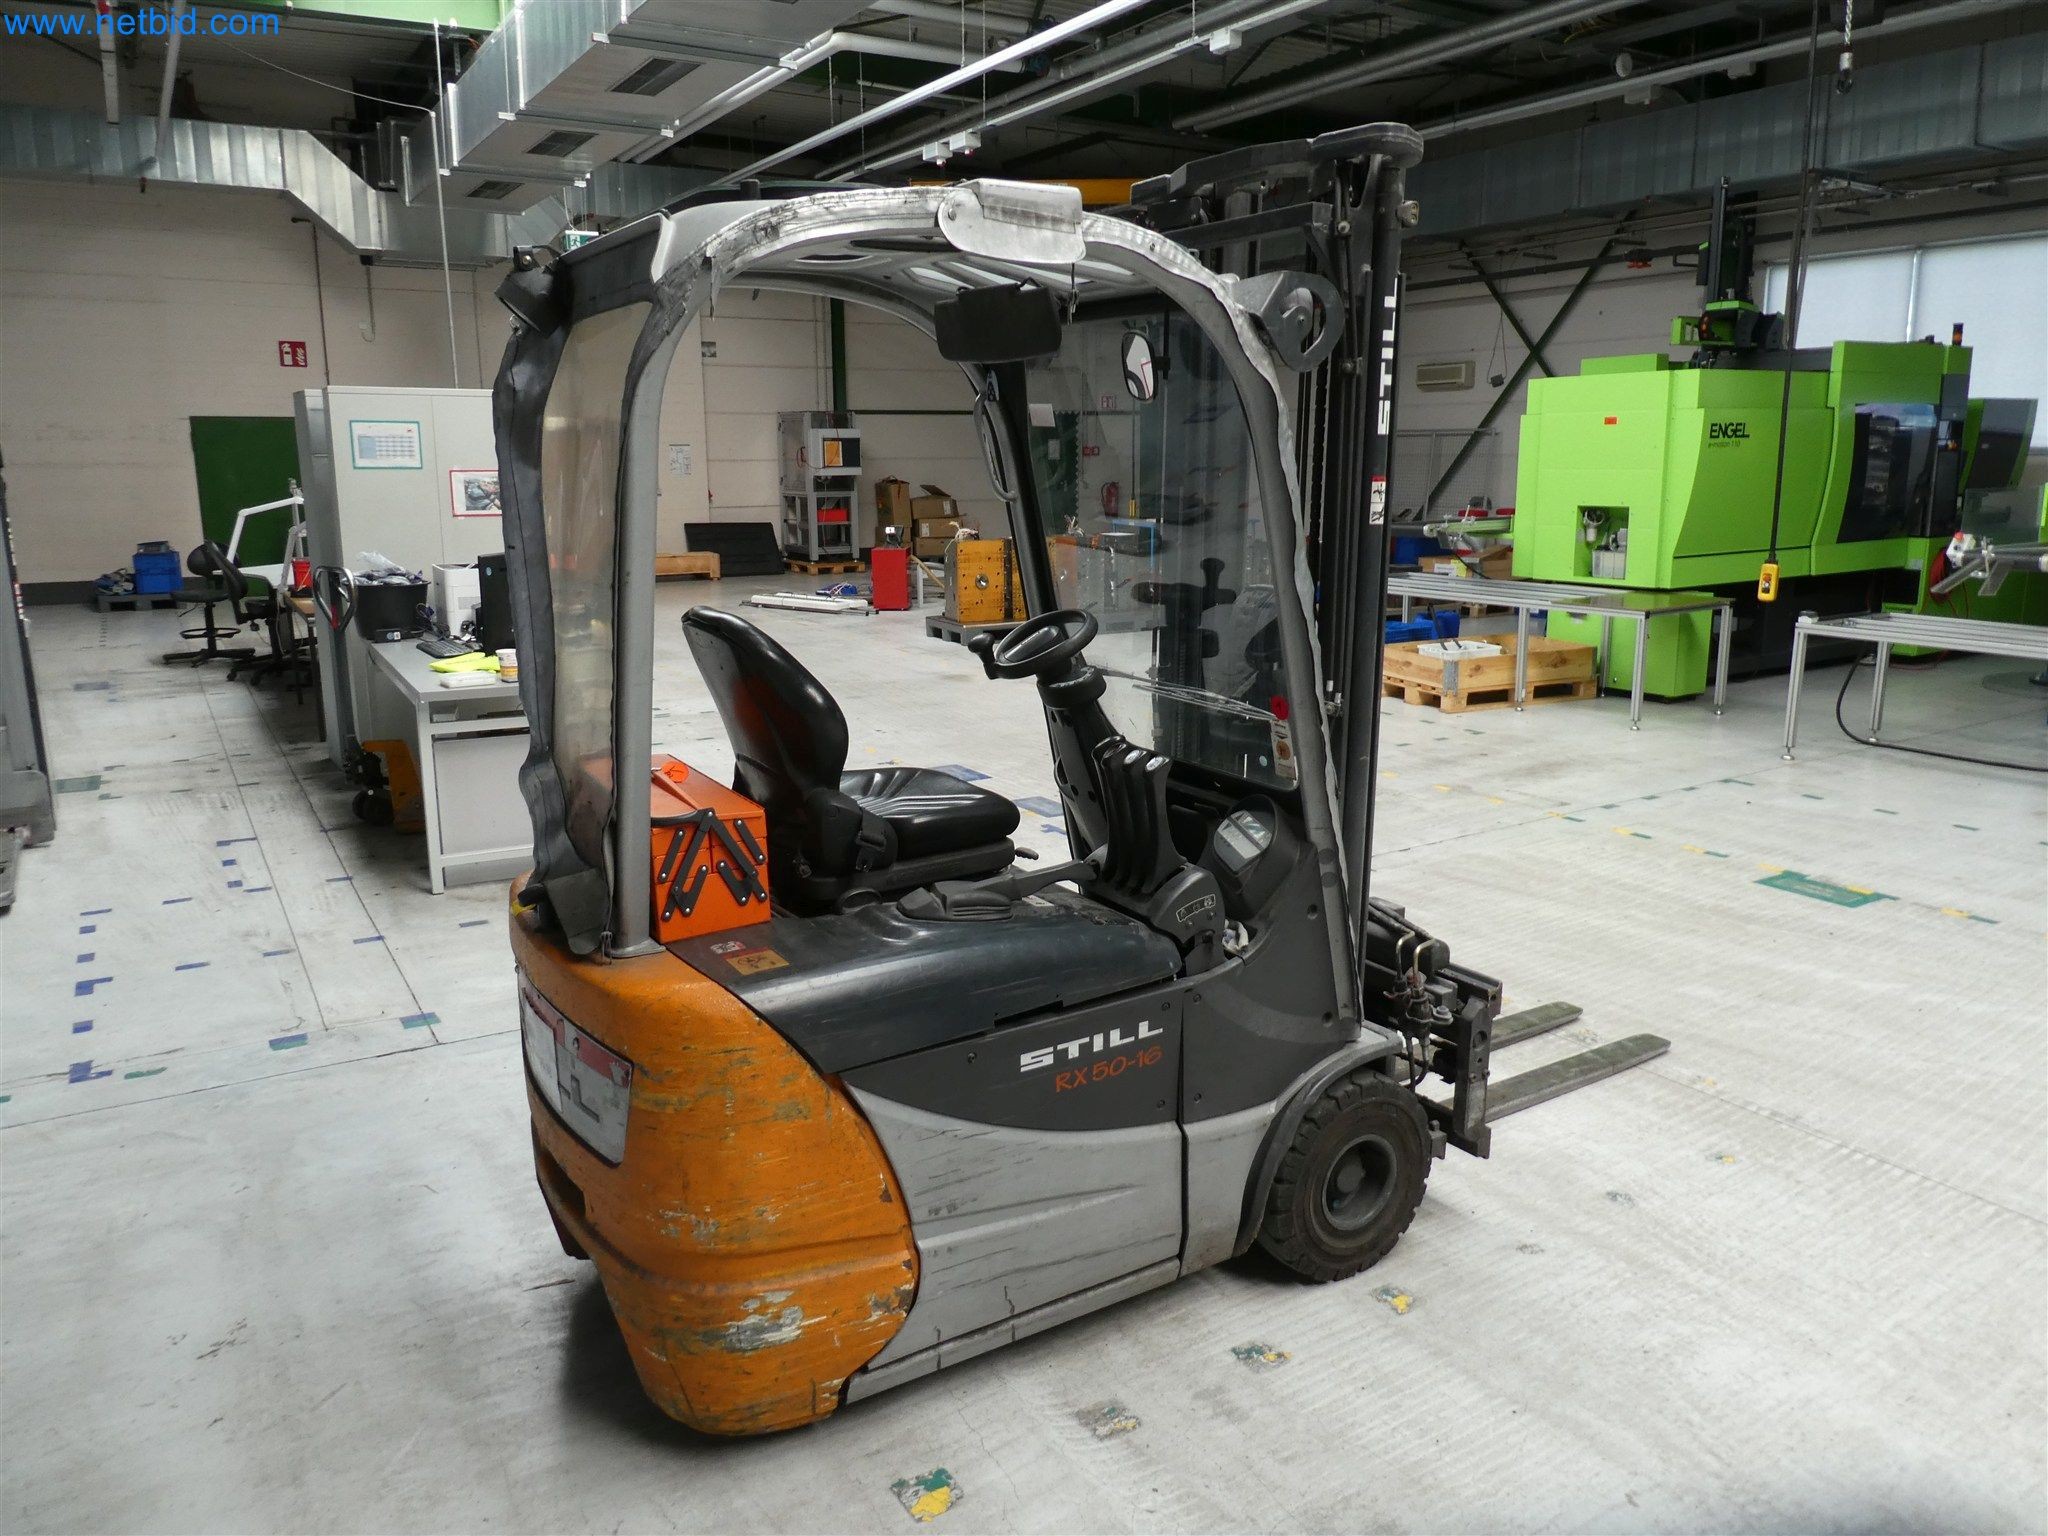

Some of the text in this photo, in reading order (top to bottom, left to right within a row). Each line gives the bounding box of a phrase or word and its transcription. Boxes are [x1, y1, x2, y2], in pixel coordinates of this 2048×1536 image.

[1377, 277, 1398, 435] STILL
[1709, 422, 1750, 439] ENGEL
[1020, 1020, 1164, 1073] STILL
[1055, 1045, 1163, 1093] RX 50-16
